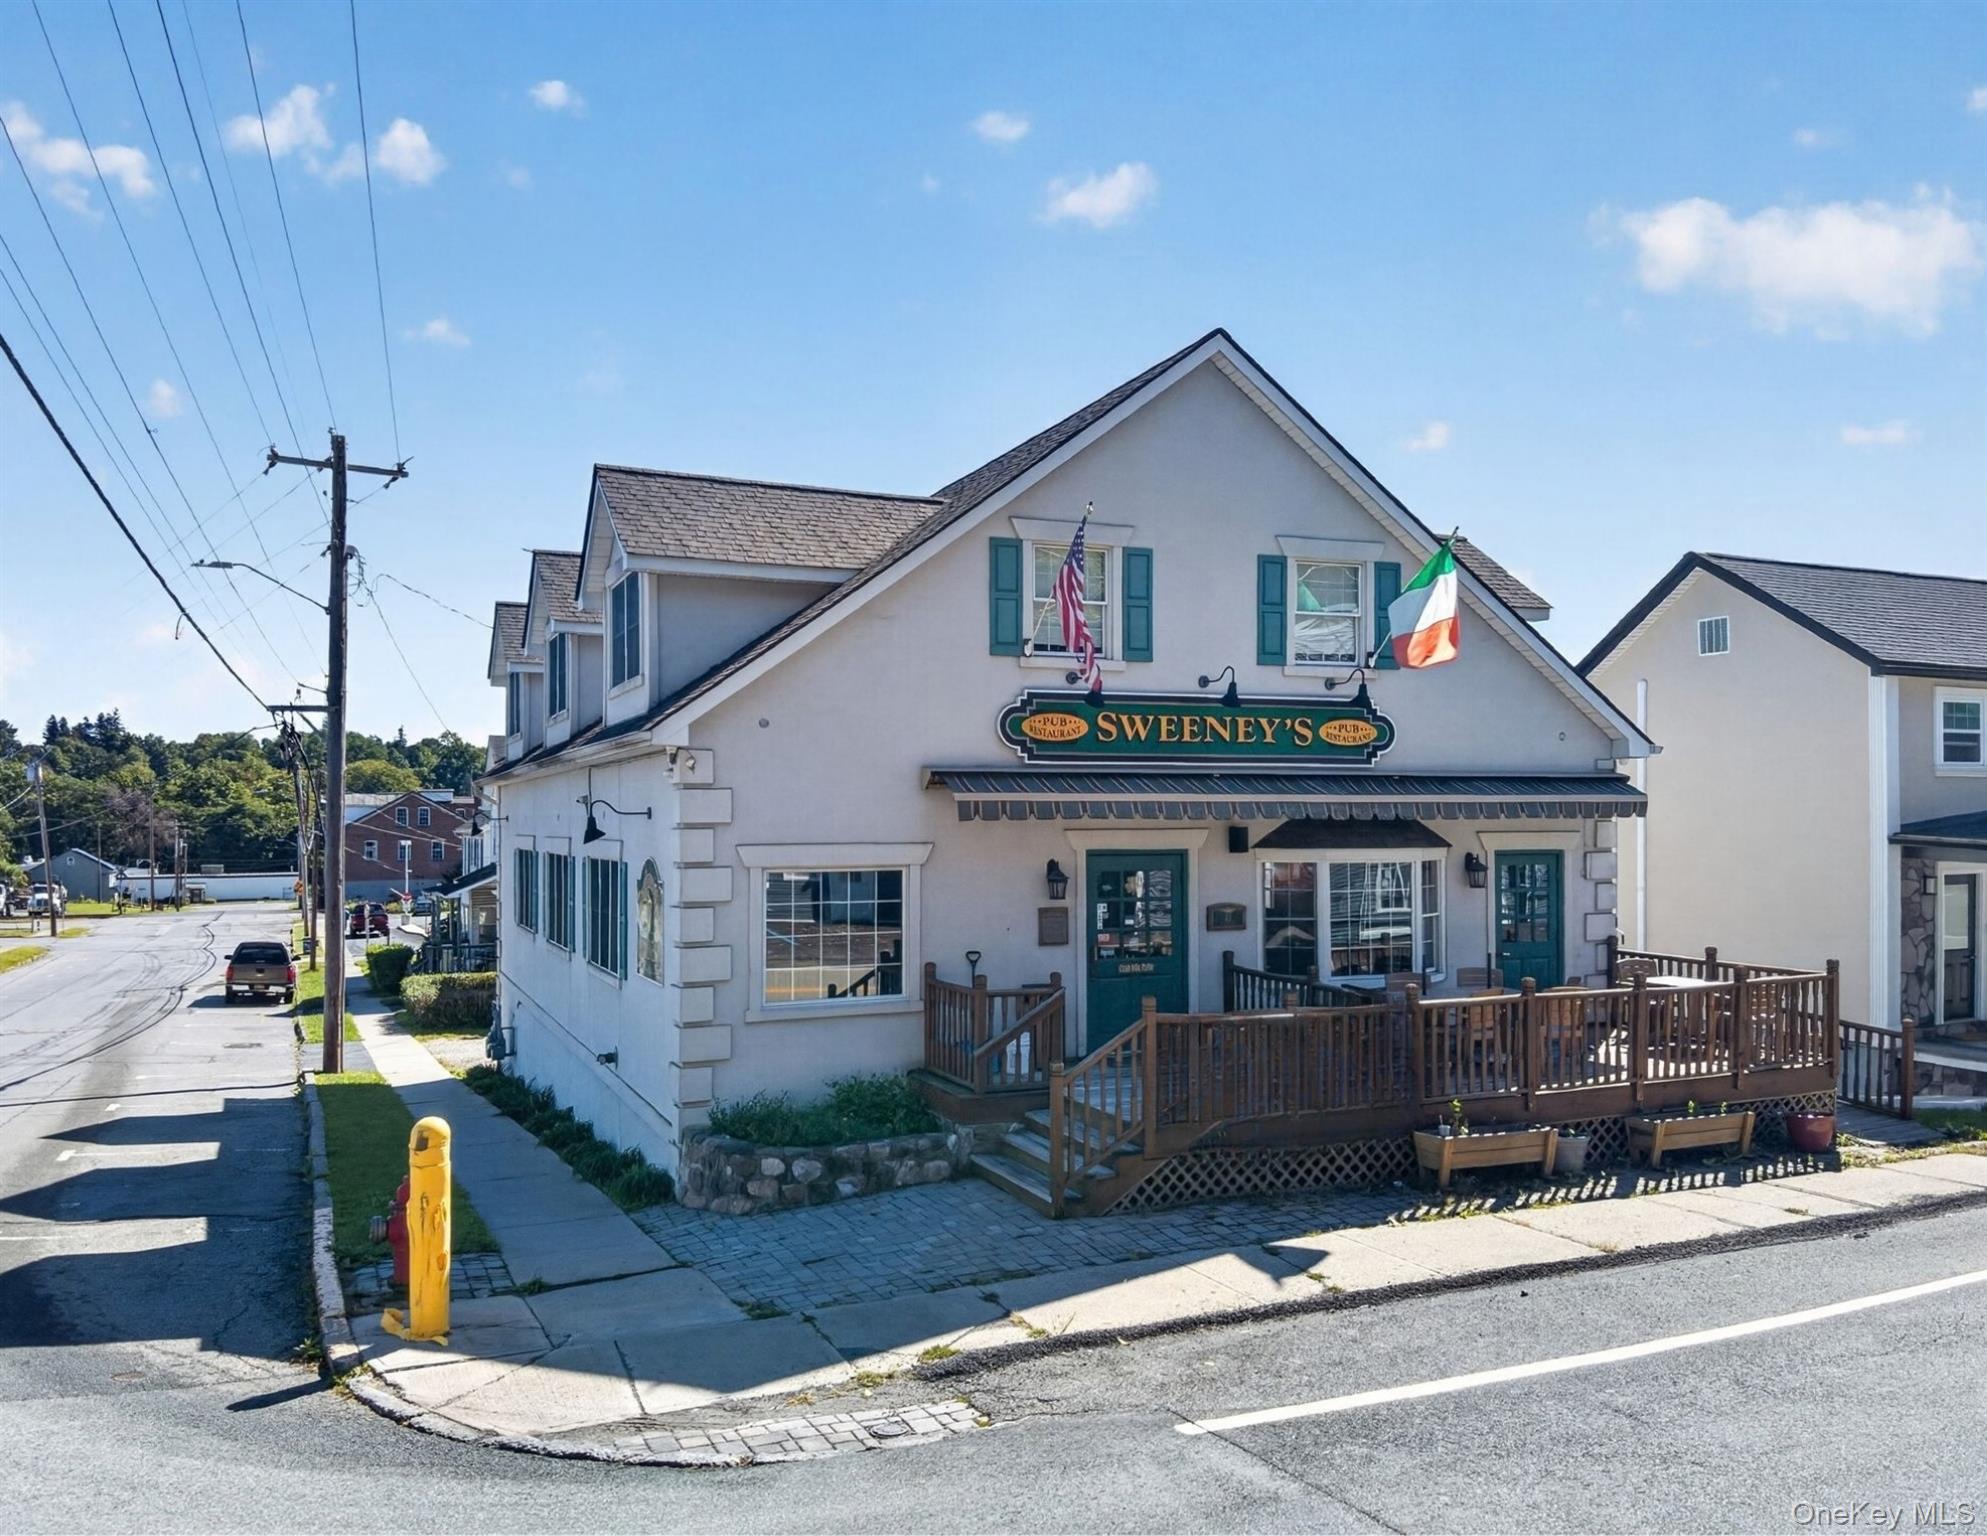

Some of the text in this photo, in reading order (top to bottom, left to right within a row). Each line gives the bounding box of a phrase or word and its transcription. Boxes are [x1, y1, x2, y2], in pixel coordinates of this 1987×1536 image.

[1043, 716, 1068, 727] PUB
[1096, 711, 1314, 747] SWEENEY'S
[1338, 723, 1360, 734] PUB
